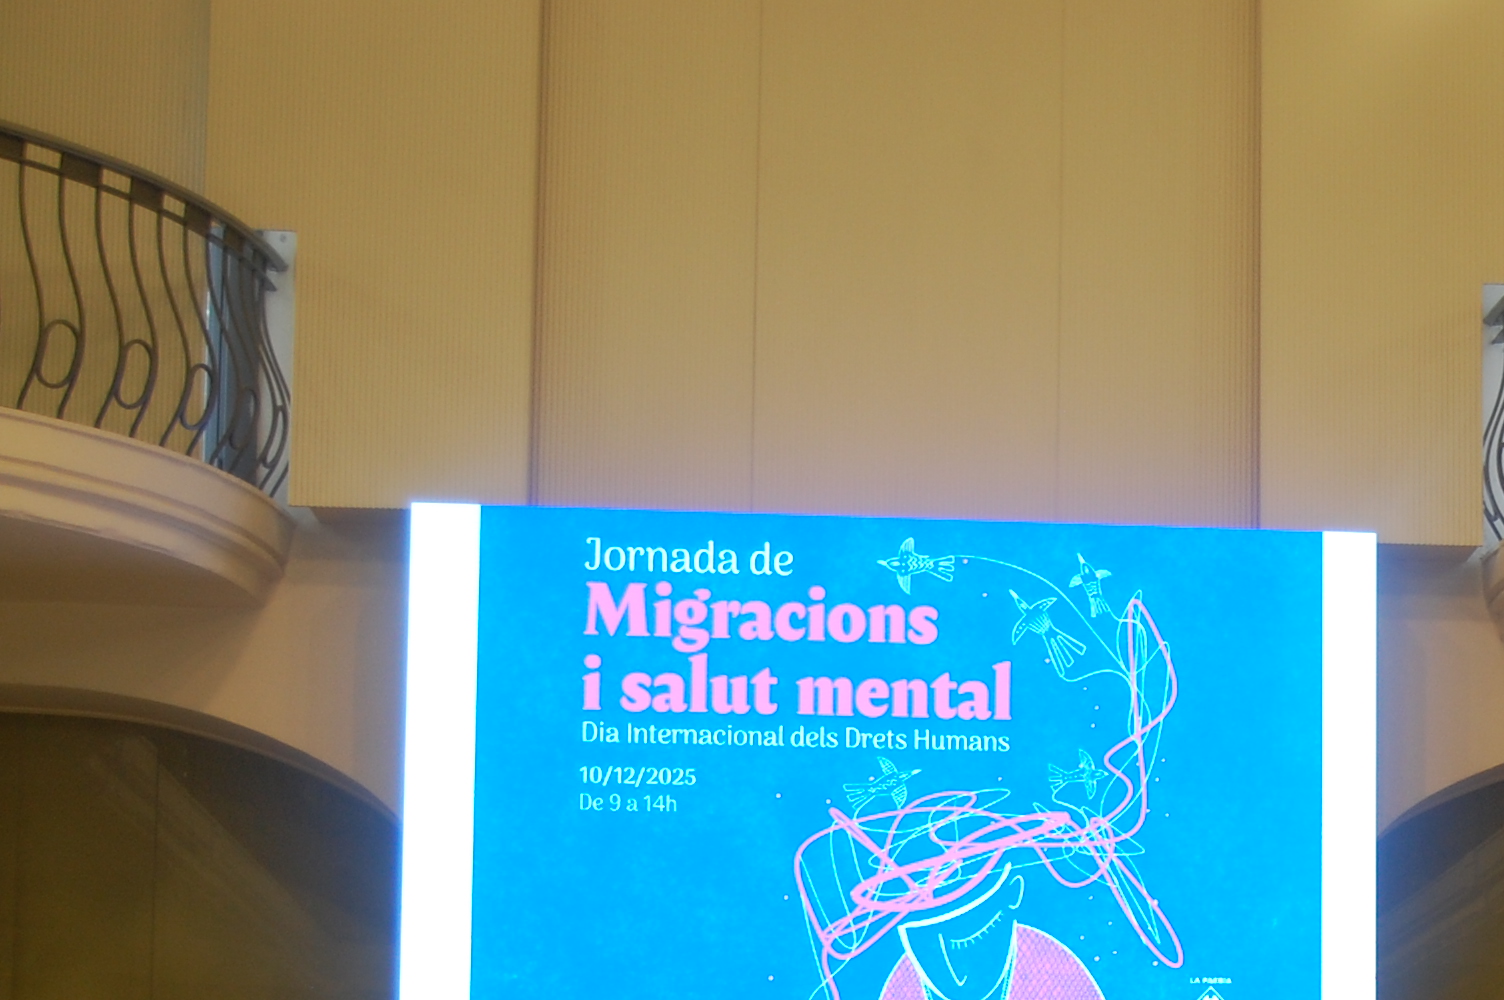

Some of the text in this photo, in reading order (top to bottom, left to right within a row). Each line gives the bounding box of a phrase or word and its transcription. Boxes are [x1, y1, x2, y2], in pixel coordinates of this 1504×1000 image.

[584, 537, 794, 576] Jornada de
[583, 581, 939, 652] Migracions
[582, 653, 1012, 720] i salut mental
[582, 721, 1010, 752] Dia Internacional dels Drets Humans
[579, 765, 697, 788] 10/12/2025
[579, 793, 677, 812] De 9 a 14h
